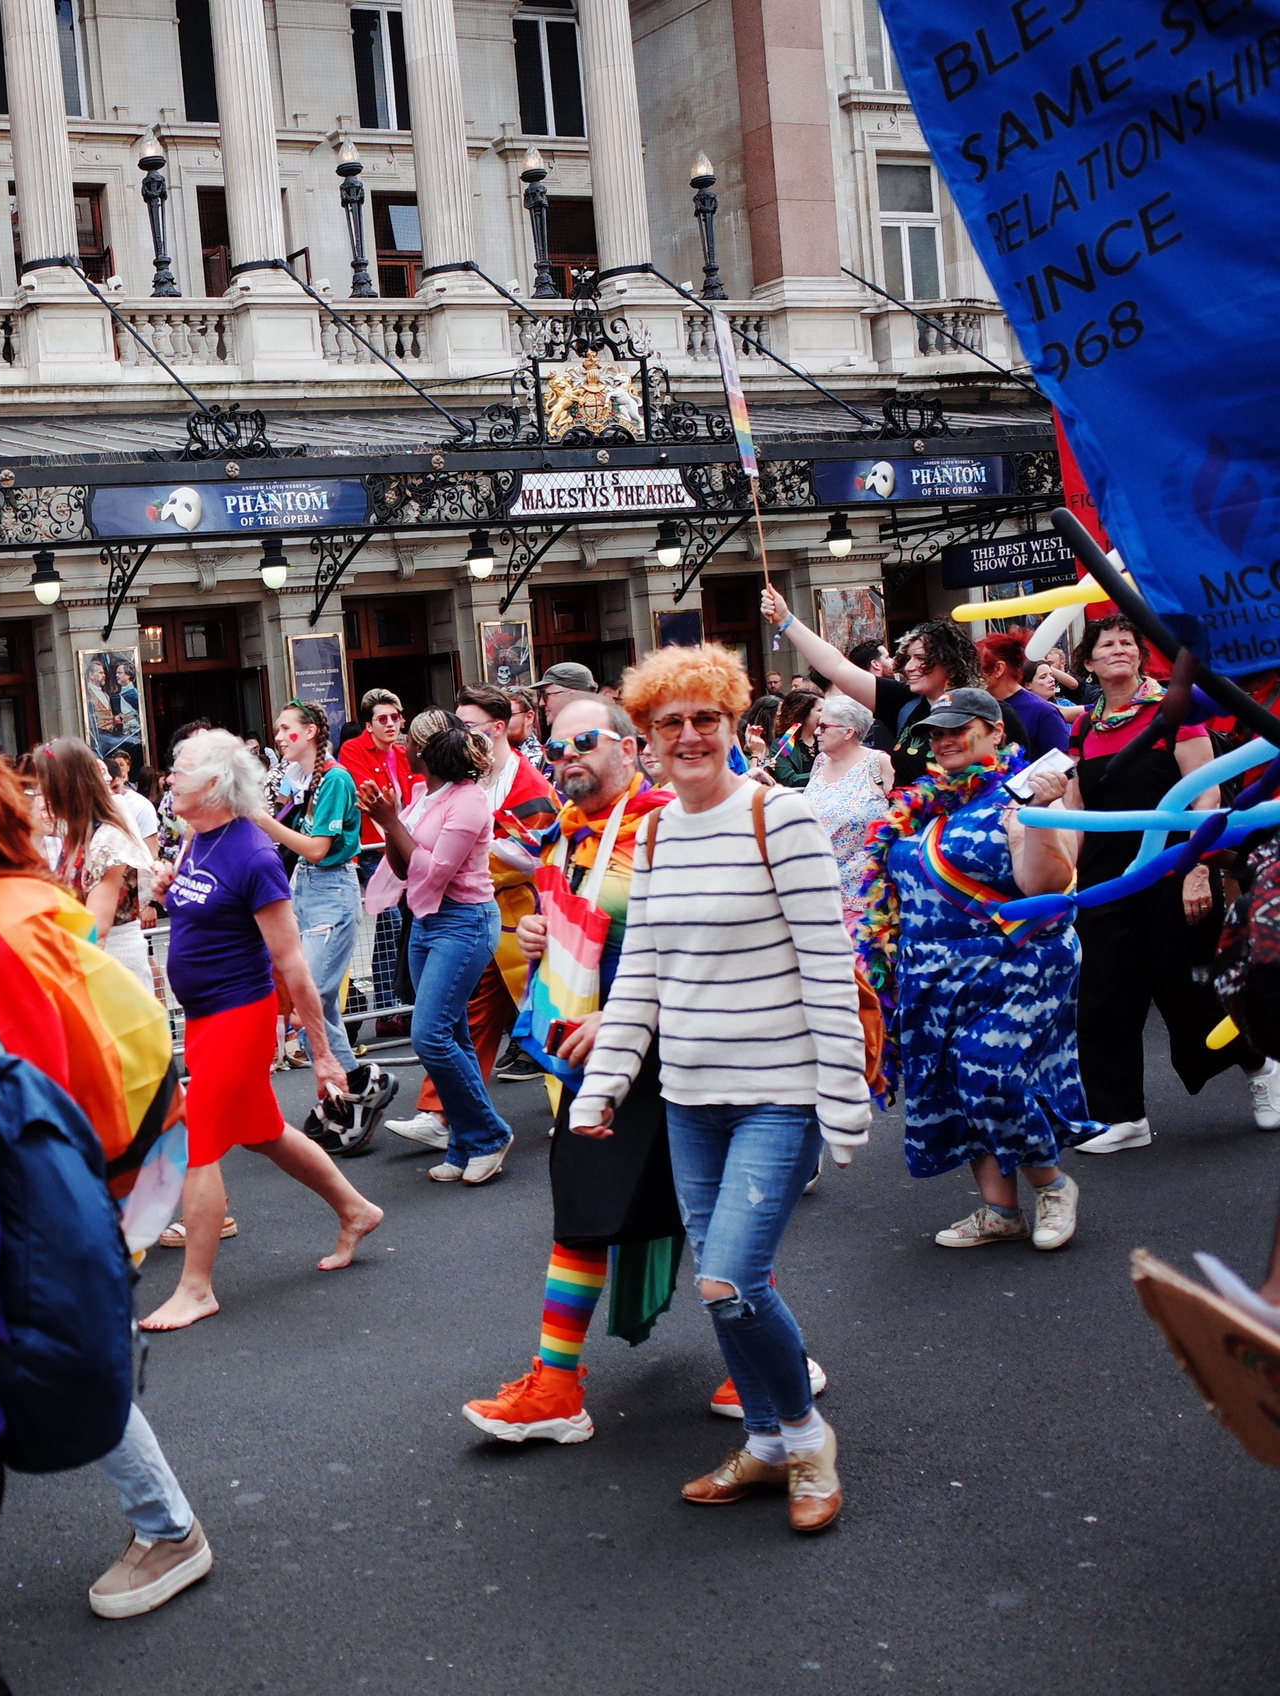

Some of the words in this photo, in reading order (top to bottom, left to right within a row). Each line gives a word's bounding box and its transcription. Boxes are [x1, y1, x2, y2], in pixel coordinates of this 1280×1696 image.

[961, 0, 1252, 182] SAME-SE
[1014, 192, 1183, 322] INCE
[585, 473, 619, 487] HIS
[911, 466, 987, 485] PHANTOM
[613, 483, 685, 506] THEATRE
[922, 488, 932, 496] OF
[935, 487, 950, 495] THE
[952, 486, 978, 495] OPERA
[224, 490, 330, 513] PHANTOM
[240, 517, 255, 527] OF
[258, 515, 280, 525] THE
[283, 514, 318, 525] OPERA
[971, 548, 995, 561] THE
[998, 542, 1027, 557] BEST
[973, 557, 1009, 572] SHOW
[1011, 553, 1029, 567] OF
[1032, 550, 1056, 564] ALL
